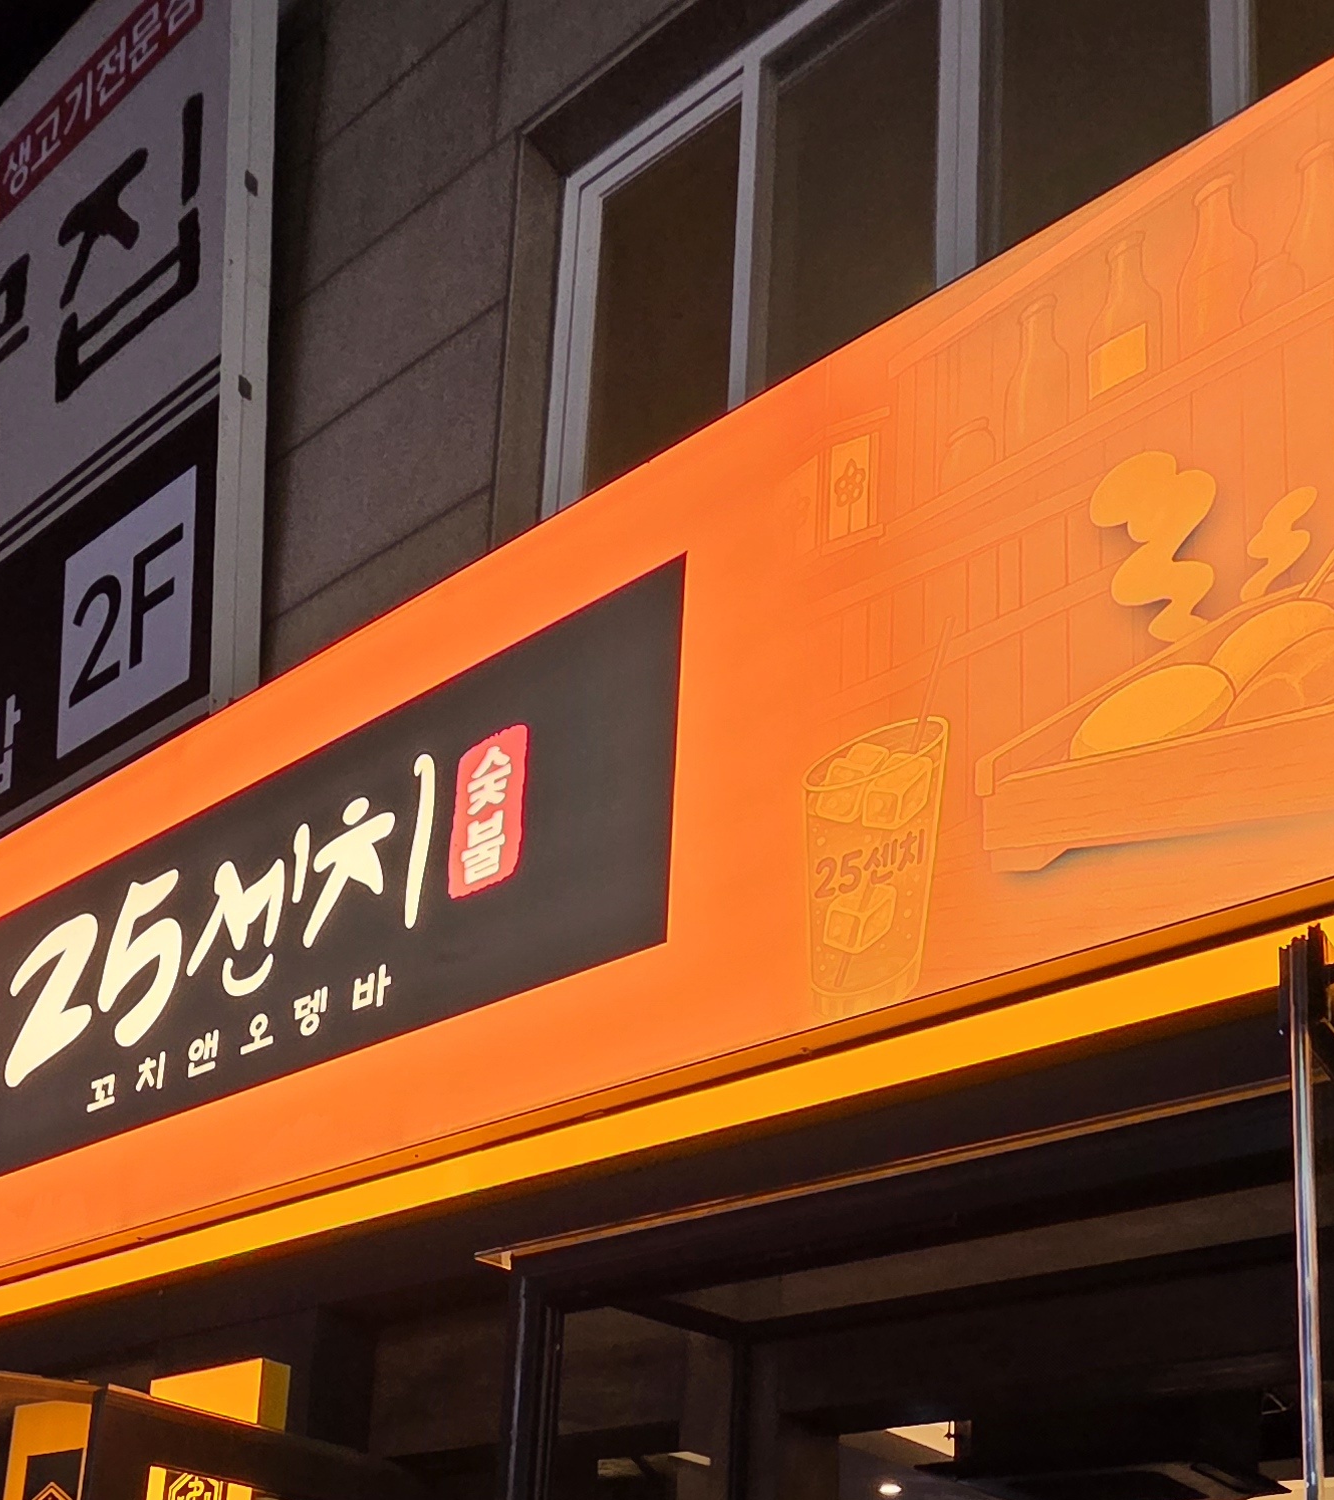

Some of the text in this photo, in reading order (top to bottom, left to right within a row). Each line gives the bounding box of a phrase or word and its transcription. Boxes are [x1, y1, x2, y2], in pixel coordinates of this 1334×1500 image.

[69, 521, 185, 708] 2F
[460, 746, 513, 886] 숯불
[813, 828, 926, 901] 25센치
